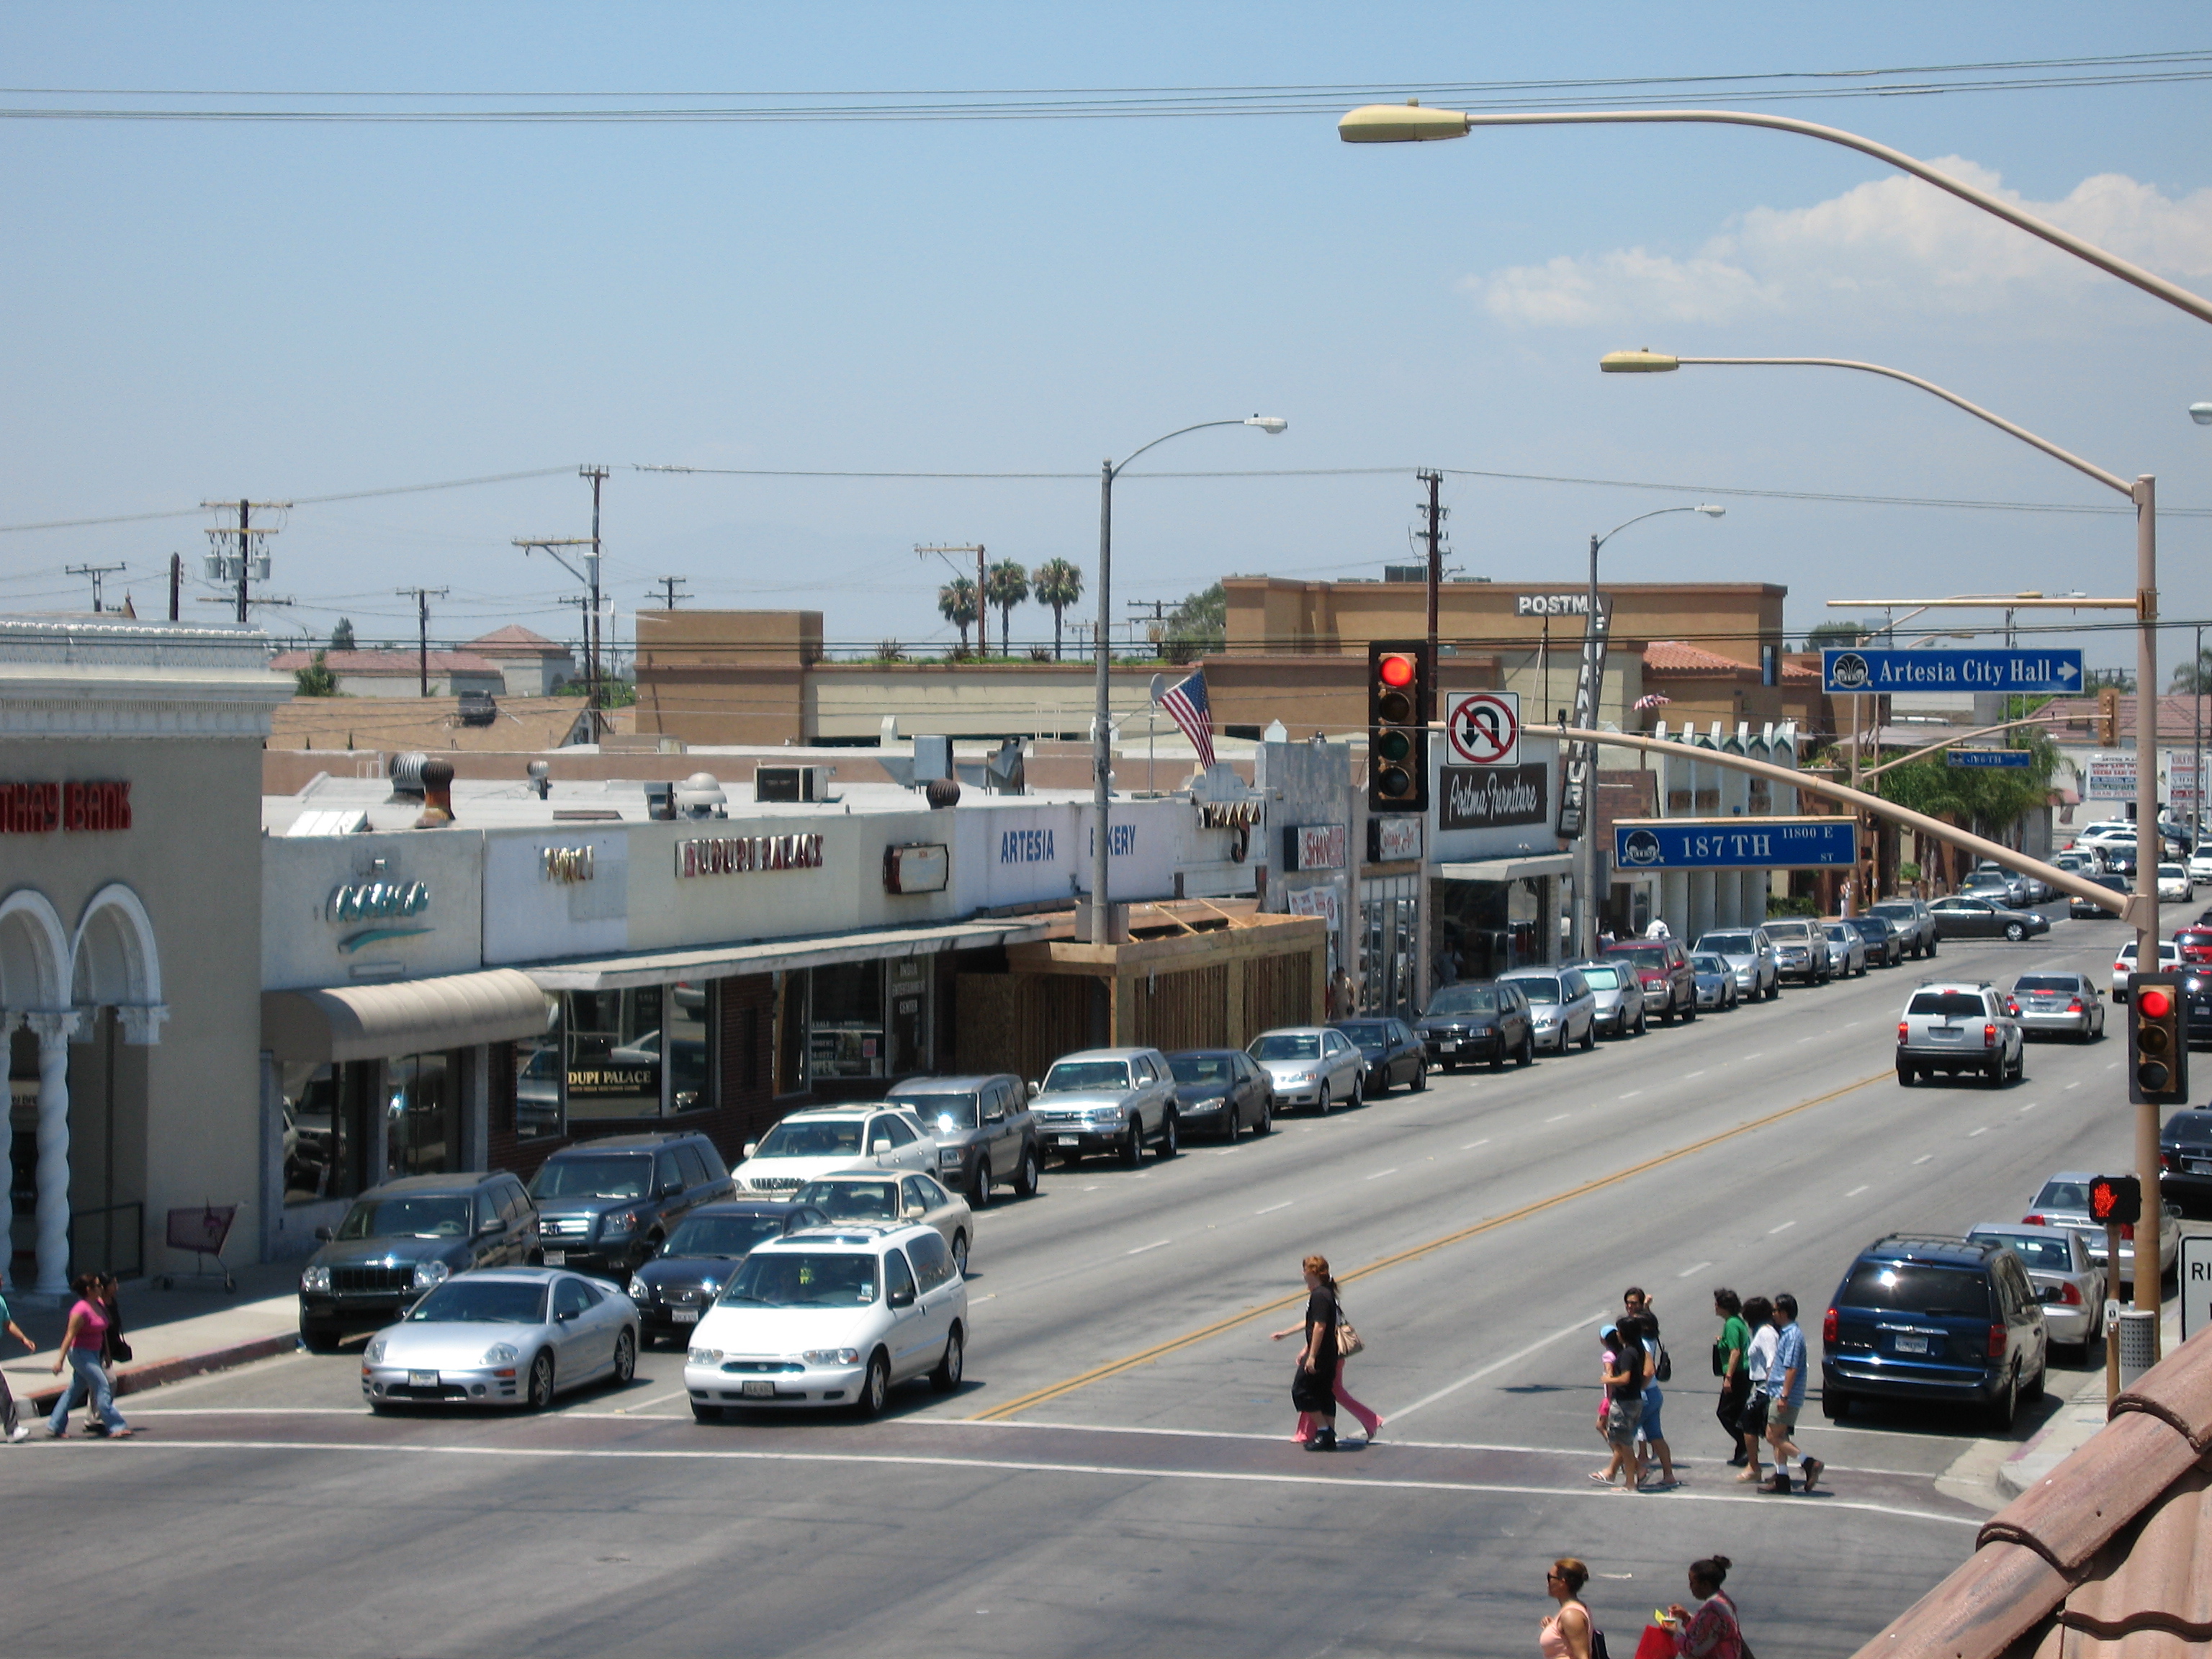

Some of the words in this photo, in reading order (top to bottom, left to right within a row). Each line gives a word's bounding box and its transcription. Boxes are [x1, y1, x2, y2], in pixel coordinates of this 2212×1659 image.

[1879, 659, 1956, 682] Artesia
[1963, 659, 2004, 685] City
[2010, 659, 2051, 682] Hall
[64, 781, 132, 831] BANK
[1783, 827, 1817, 839] 11800
[1824, 826, 1833, 838] E
[1002, 830, 1054, 863] ARTESIA
[1820, 853, 1834, 862] ST
[567, 1071, 599, 1084] DUPI
[603, 1070, 651, 1084] PALACE
